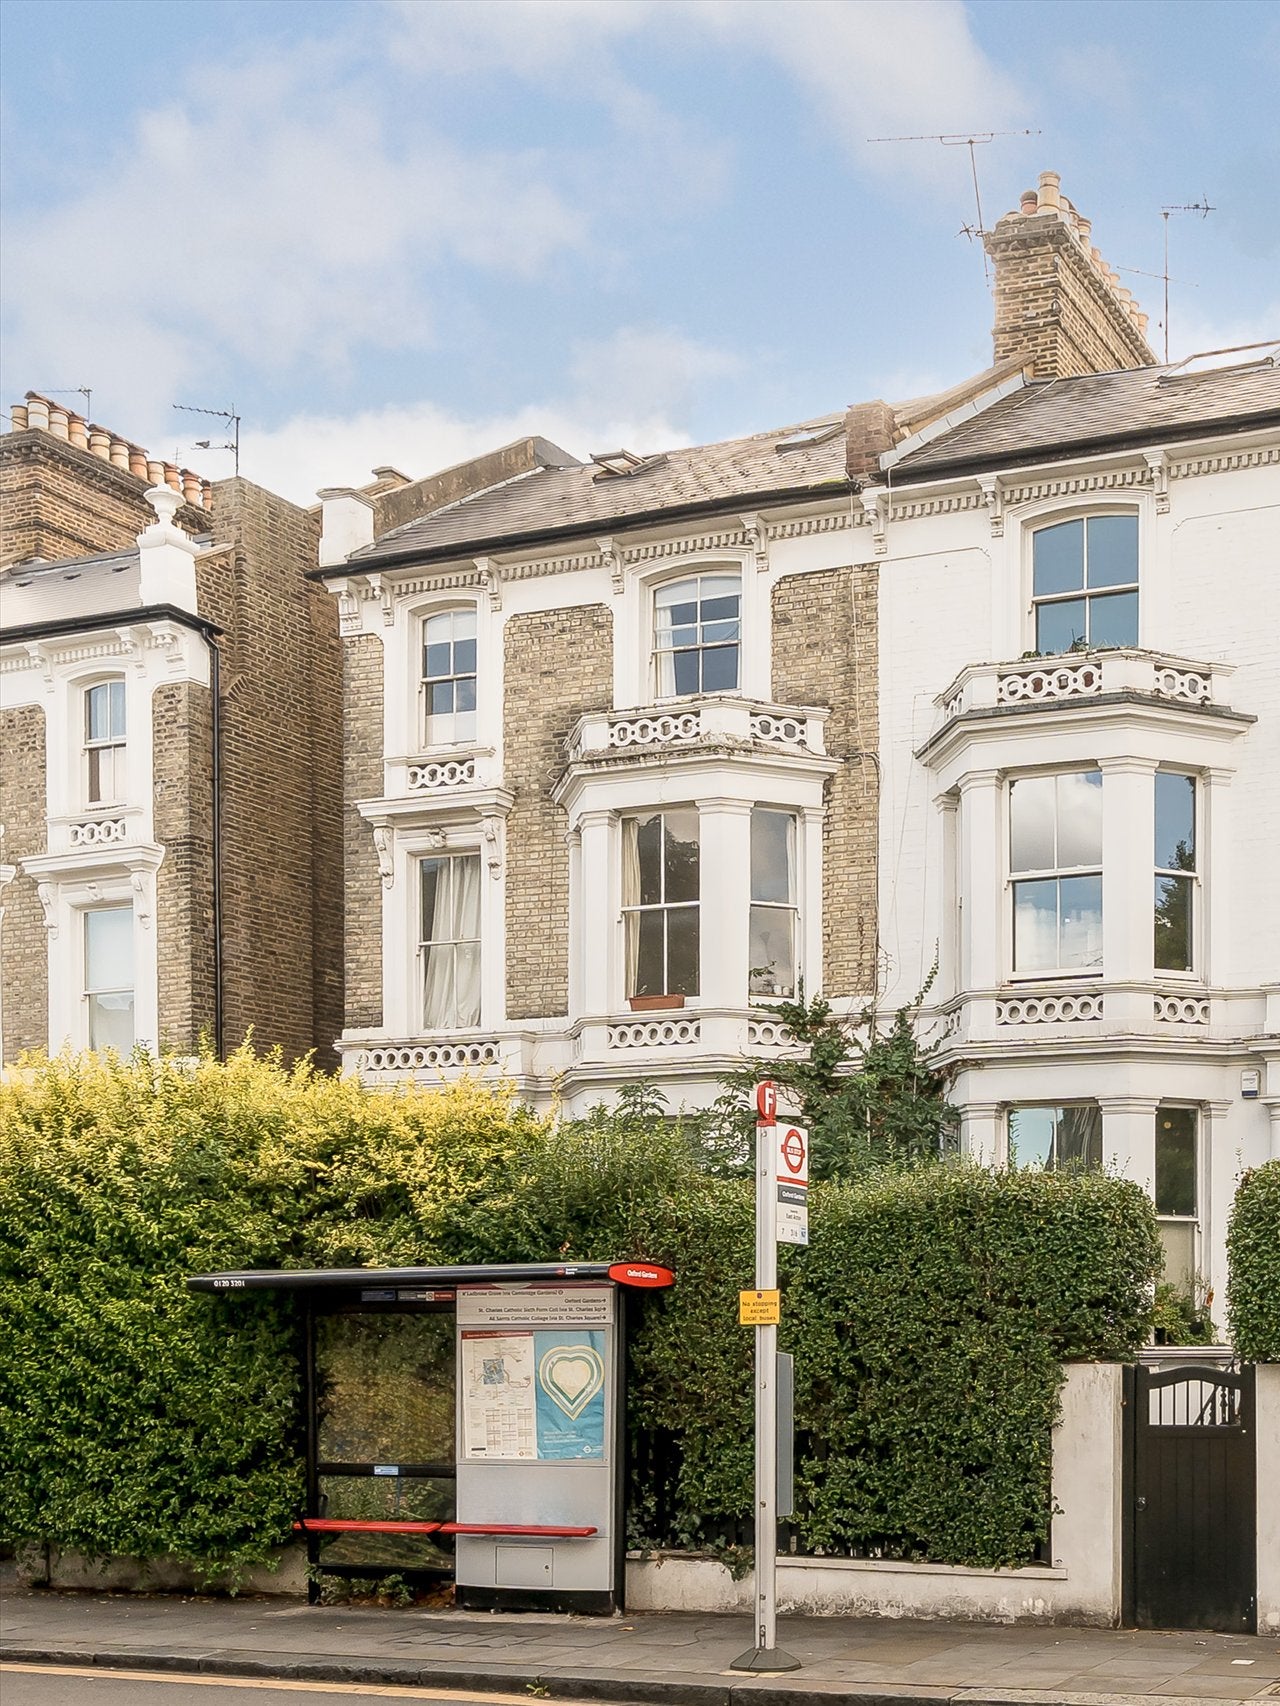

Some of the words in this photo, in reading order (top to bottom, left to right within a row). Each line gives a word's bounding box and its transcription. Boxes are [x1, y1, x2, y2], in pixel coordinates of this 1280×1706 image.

[765, 1087, 774, 1114] F
[782, 1190, 794, 1198] Oxford
[626, 1270, 641, 1278] Oxford
[642, 1270, 658, 1279] Gardens
